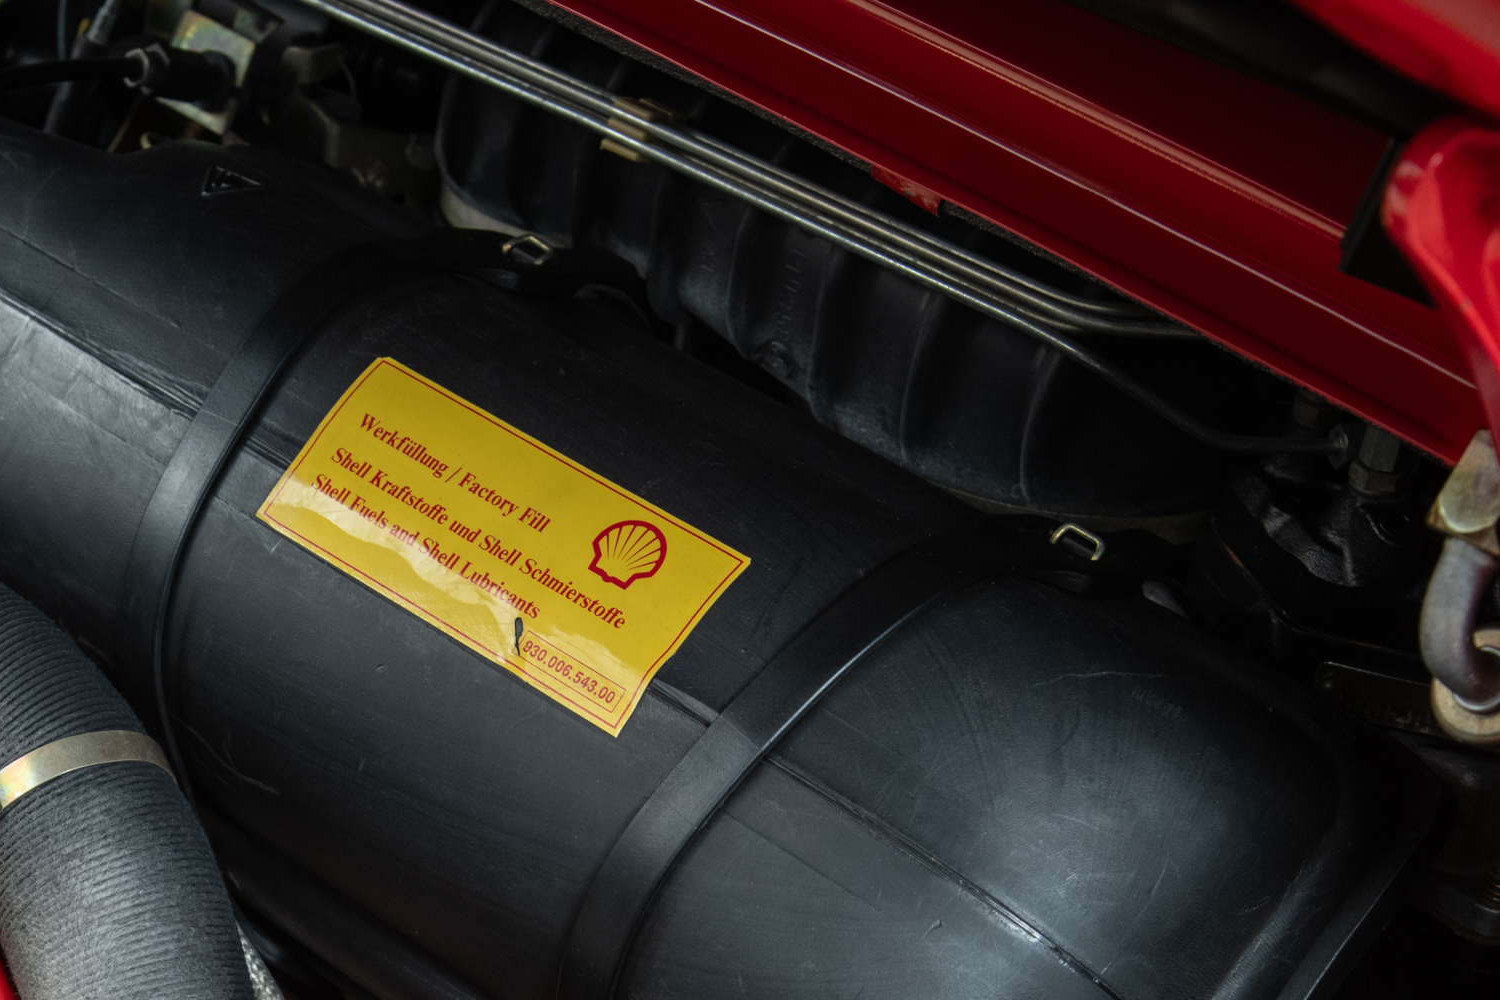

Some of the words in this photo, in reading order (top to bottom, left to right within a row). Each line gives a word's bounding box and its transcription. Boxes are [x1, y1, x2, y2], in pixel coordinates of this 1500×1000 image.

[330, 447, 372, 478] Shell
[368, 469, 448, 524] Kraftstoffe
[448, 520, 482, 543] und
[477, 534, 522, 566] Shell
[518, 558, 625, 628] Schmierstoffe
[360, 413, 449, 478] Werkfüllung
[447, 466, 462, 483] /
[457, 471, 519, 517] Factory
[517, 506, 551, 532] Fill
[310, 473, 351, 504] Shell
[348, 494, 388, 528] Fuels
[389, 524, 420, 546] and
[417, 536, 460, 571] Shell
[458, 560, 540, 619] Lubricants
[522, 640, 615, 703] 930.006.543.00
